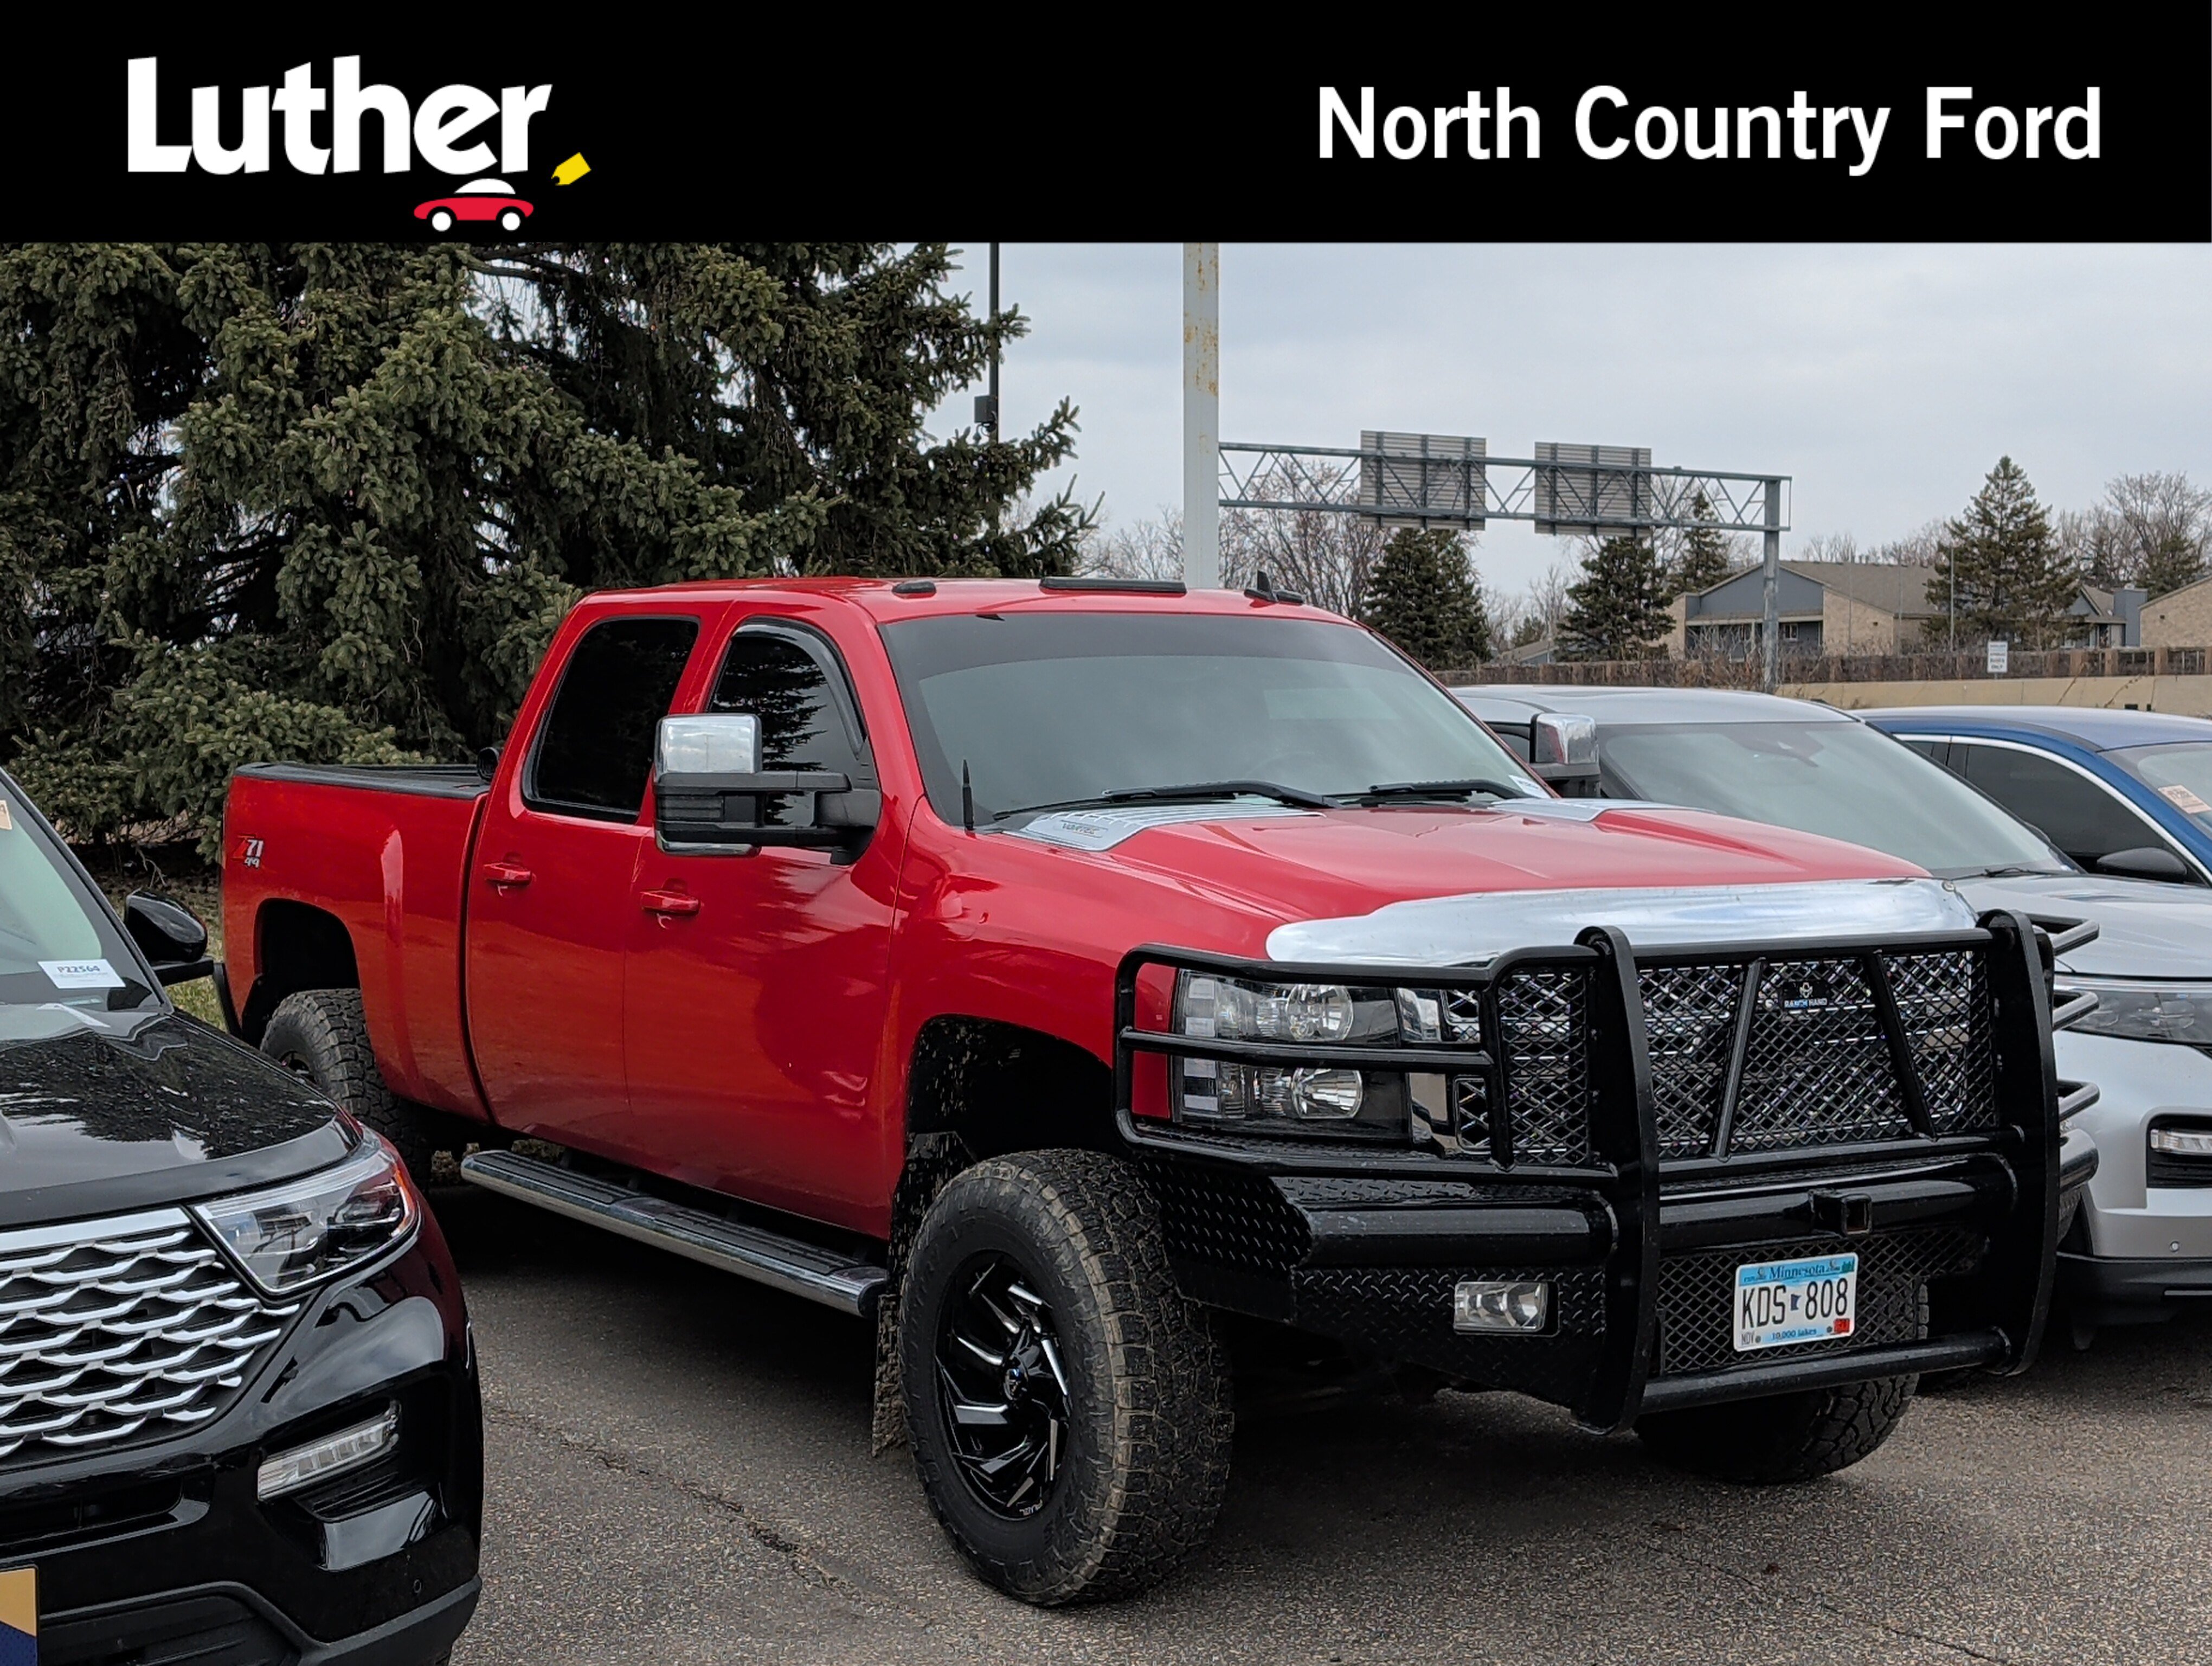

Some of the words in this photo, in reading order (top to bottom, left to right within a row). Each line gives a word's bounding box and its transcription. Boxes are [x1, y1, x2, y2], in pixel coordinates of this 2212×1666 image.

[232, 835, 264, 858] Z71
[1784, 999, 1808, 1008] RANCH
[1809, 997, 1828, 1007] HAND
[1769, 1265, 1825, 1279] Minnesota
[1741, 1285, 1786, 1329] KDS
[1805, 1278, 1849, 1320] 808
